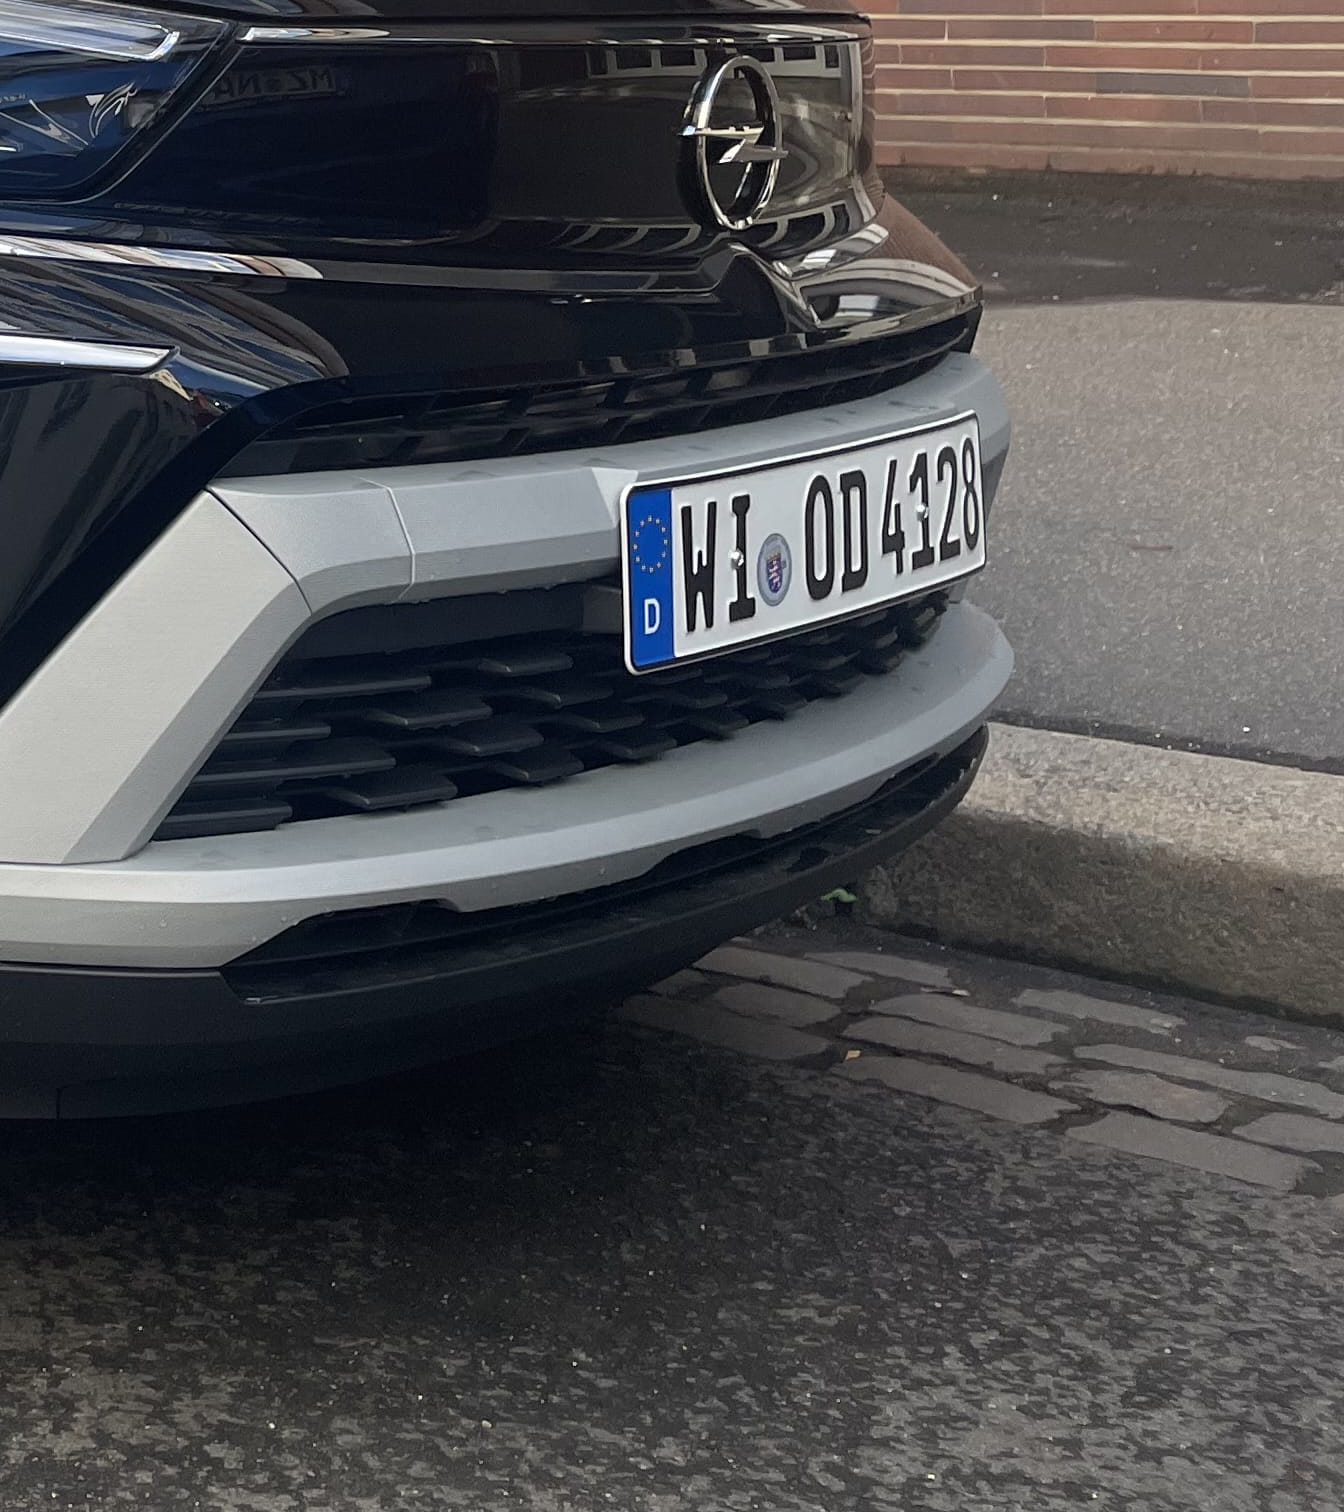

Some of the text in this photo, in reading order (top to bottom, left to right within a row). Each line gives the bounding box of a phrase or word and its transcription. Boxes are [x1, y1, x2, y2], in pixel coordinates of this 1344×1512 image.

[680, 437, 980, 633] WI OD 4128
[643, 598, 660, 636] D
